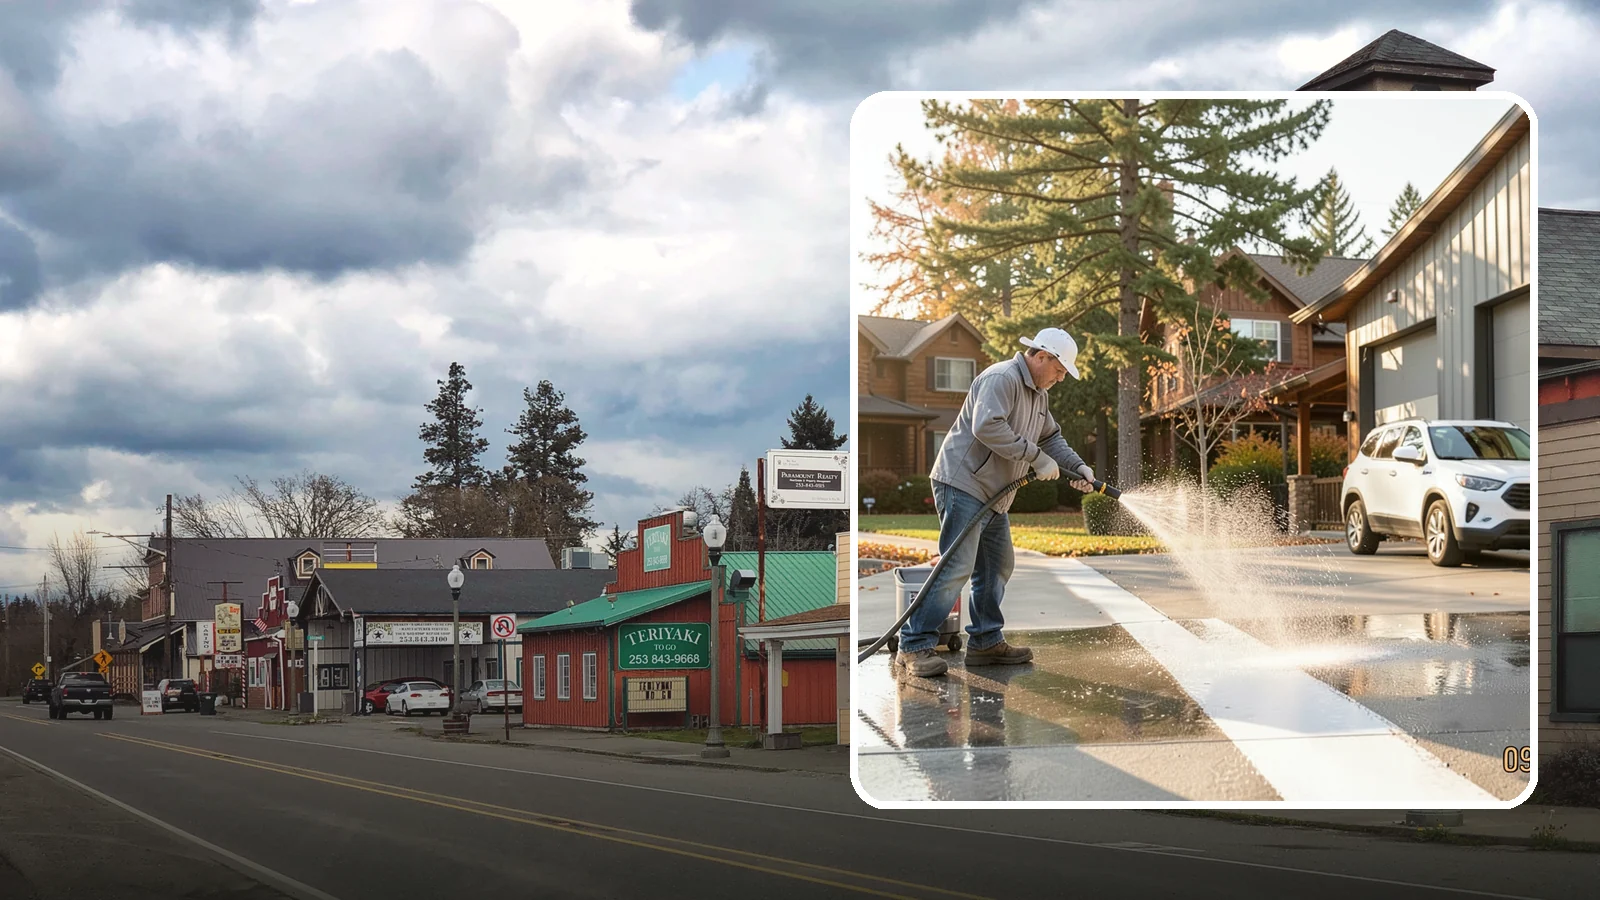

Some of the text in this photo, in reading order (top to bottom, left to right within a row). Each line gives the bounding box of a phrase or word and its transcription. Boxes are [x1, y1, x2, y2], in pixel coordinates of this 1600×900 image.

[625, 627, 702, 646] TERIYAKI
[628, 654, 700, 664] 253 843-9668
